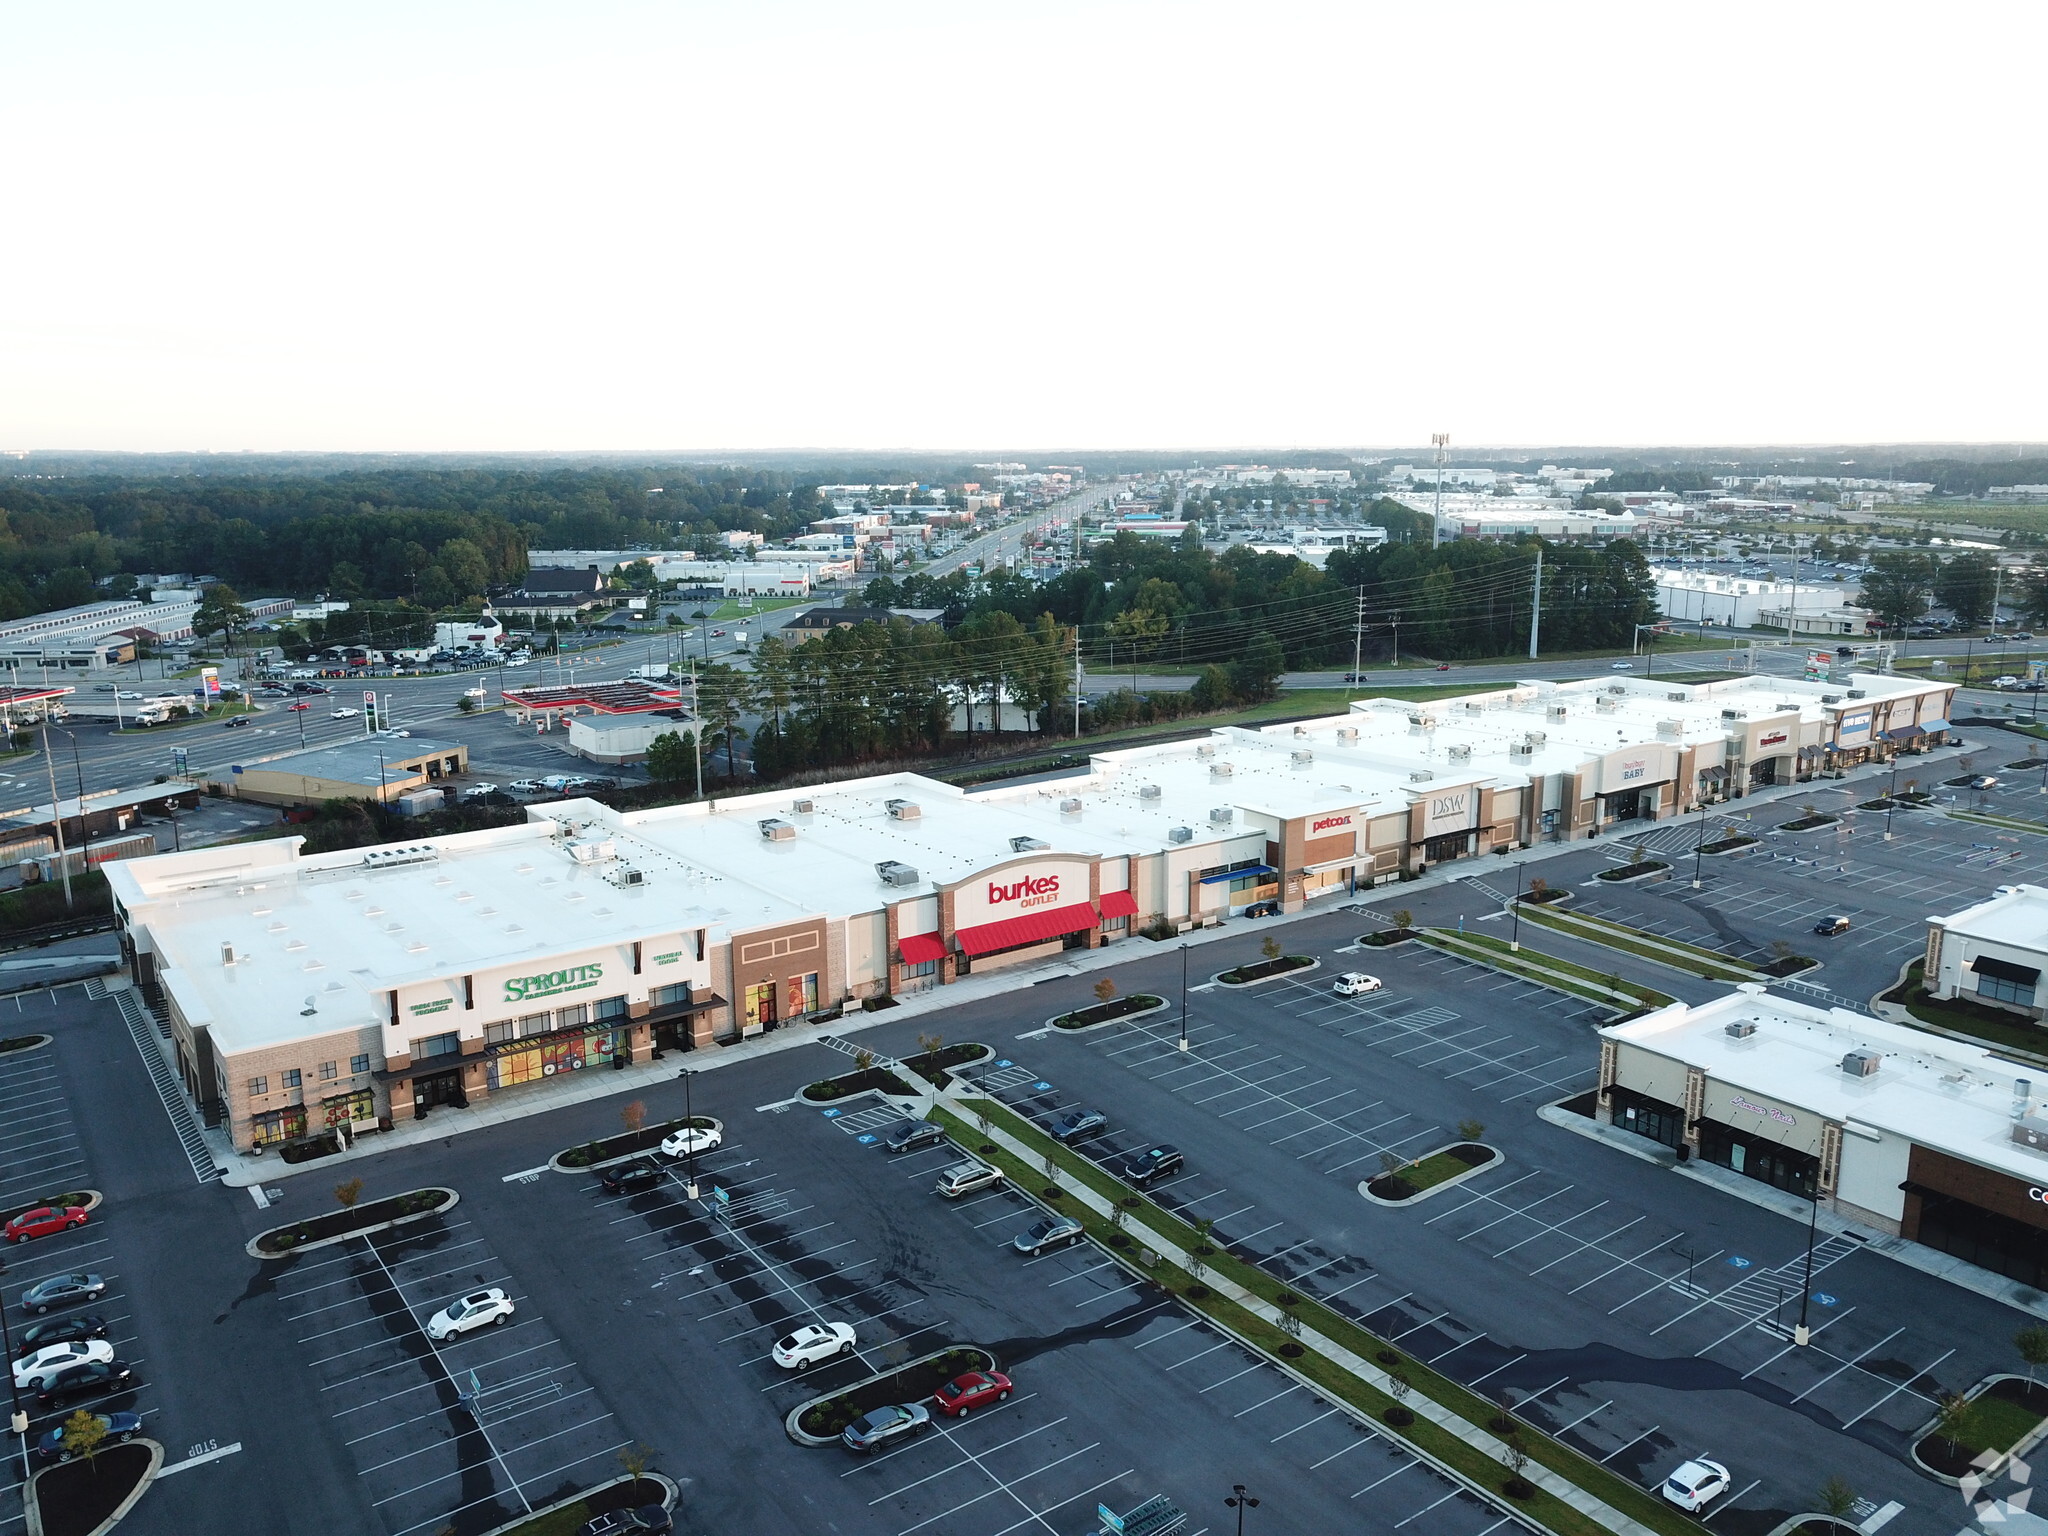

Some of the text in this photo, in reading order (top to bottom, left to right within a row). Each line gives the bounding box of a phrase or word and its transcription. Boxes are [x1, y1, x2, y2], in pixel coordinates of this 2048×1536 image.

[1624, 768, 1646, 780] BABY
[1433, 794, 1465, 815] DSW
[1313, 817, 1344, 833] petco
[988, 875, 1060, 905] burkes
[1020, 893, 1059, 908] OUTLET
[504, 963, 604, 1002] SPROUTS
[1770, 1108, 1797, 1126] Nails
[519, 1174, 540, 1185] STOP
[188, 1439, 218, 1457] STOP
